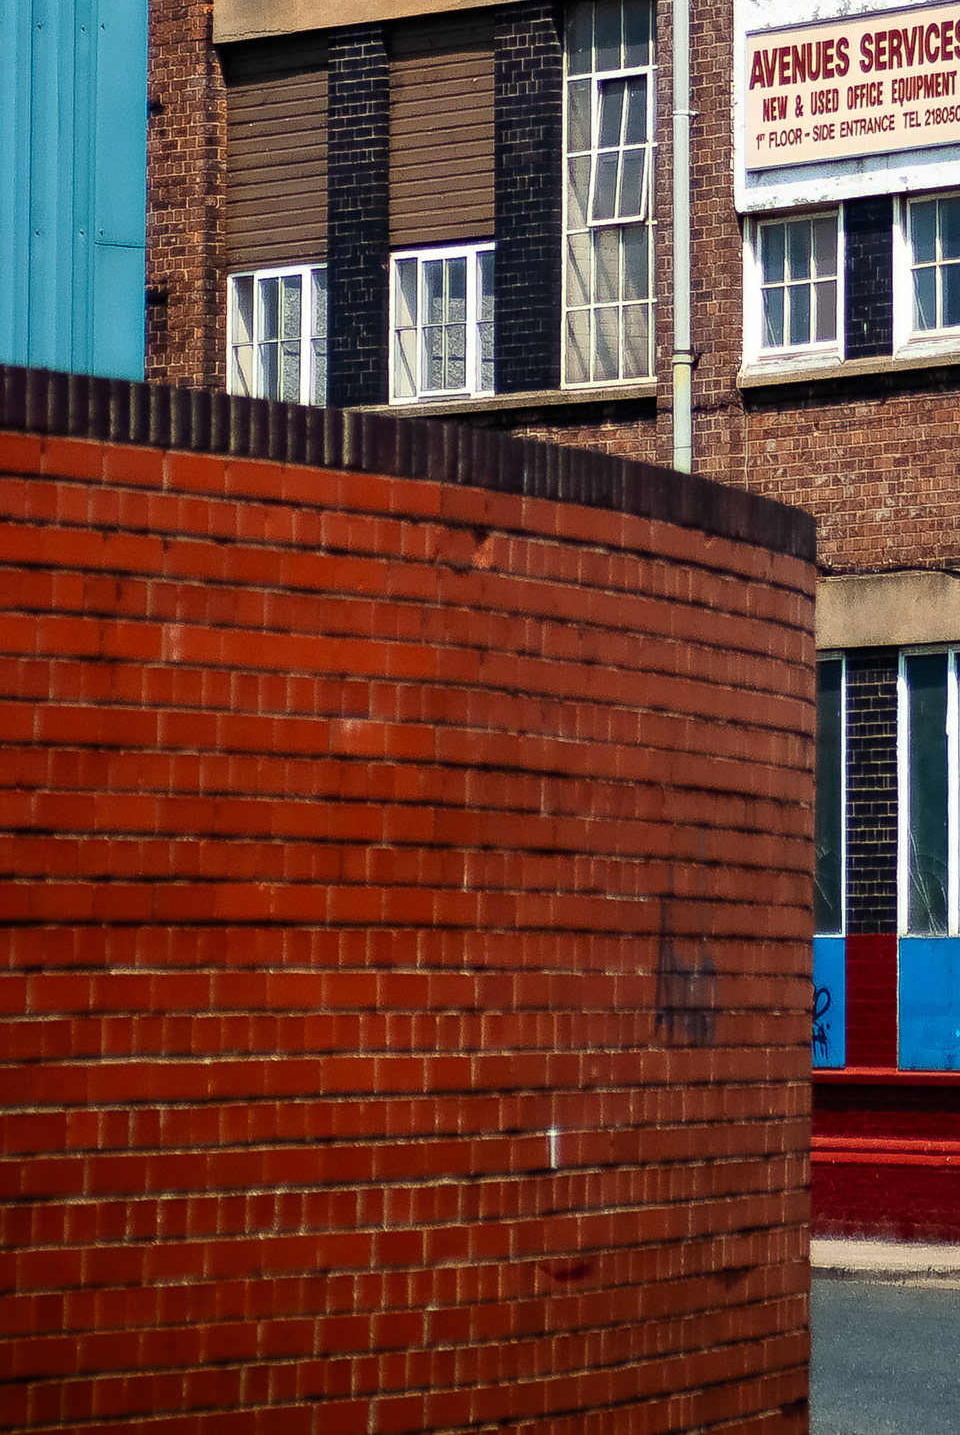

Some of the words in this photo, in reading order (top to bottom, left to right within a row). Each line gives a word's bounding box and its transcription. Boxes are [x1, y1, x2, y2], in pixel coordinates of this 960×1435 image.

[749, 37, 849, 90] AVENUES
[763, 96, 788, 122] NEW
[794, 94, 804, 118] &
[811, 88, 839, 116] USED
[847, 82, 883, 110] OFFICE
[891, 70, 958, 107] EQUIPMENT
[769, 127, 802, 148] FLOOR
[813, 123, 835, 142] SIDE
[840, 114, 895, 138] ENTRANCE
[903, 111, 921, 128] TEL
